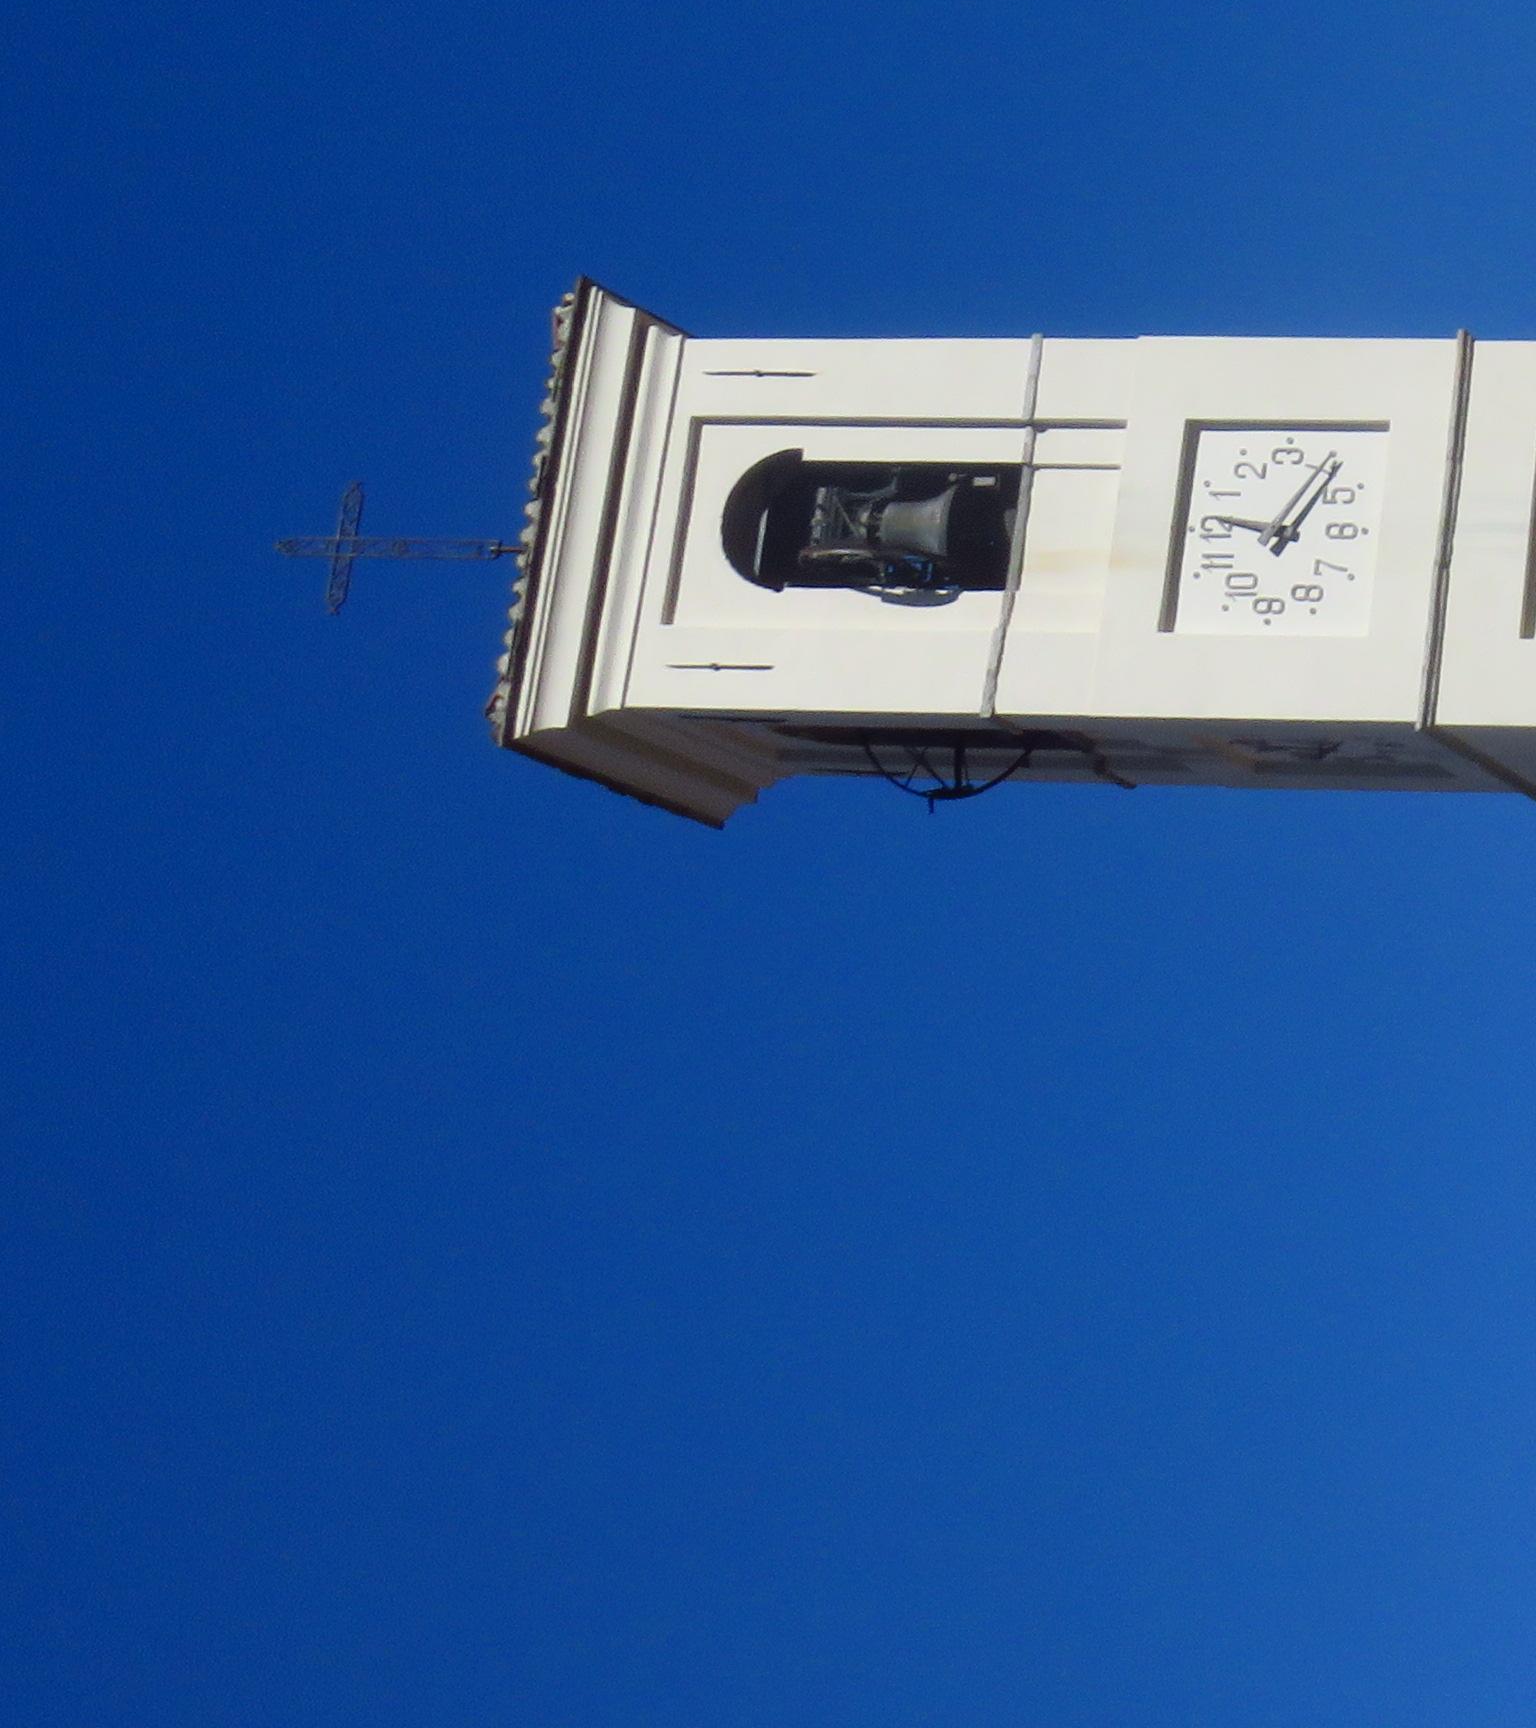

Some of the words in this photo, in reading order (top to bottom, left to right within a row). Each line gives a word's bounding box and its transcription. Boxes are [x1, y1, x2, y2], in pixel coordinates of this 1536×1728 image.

[1272, 448, 1304, 465] 3
[1234, 462, 1267, 480] 2
[1209, 491, 1241, 501] 1
[1322, 487, 1355, 504] 5
[1200, 516, 1233, 543] 12
[1326, 523, 1359, 539] 6
[1201, 553, 1234, 573] 11
[1314, 559, 1348, 576] 7
[1225, 573, 1258, 601] 10
[1292, 585, 1324, 602] 8
[1253, 597, 1285, 614] 9
